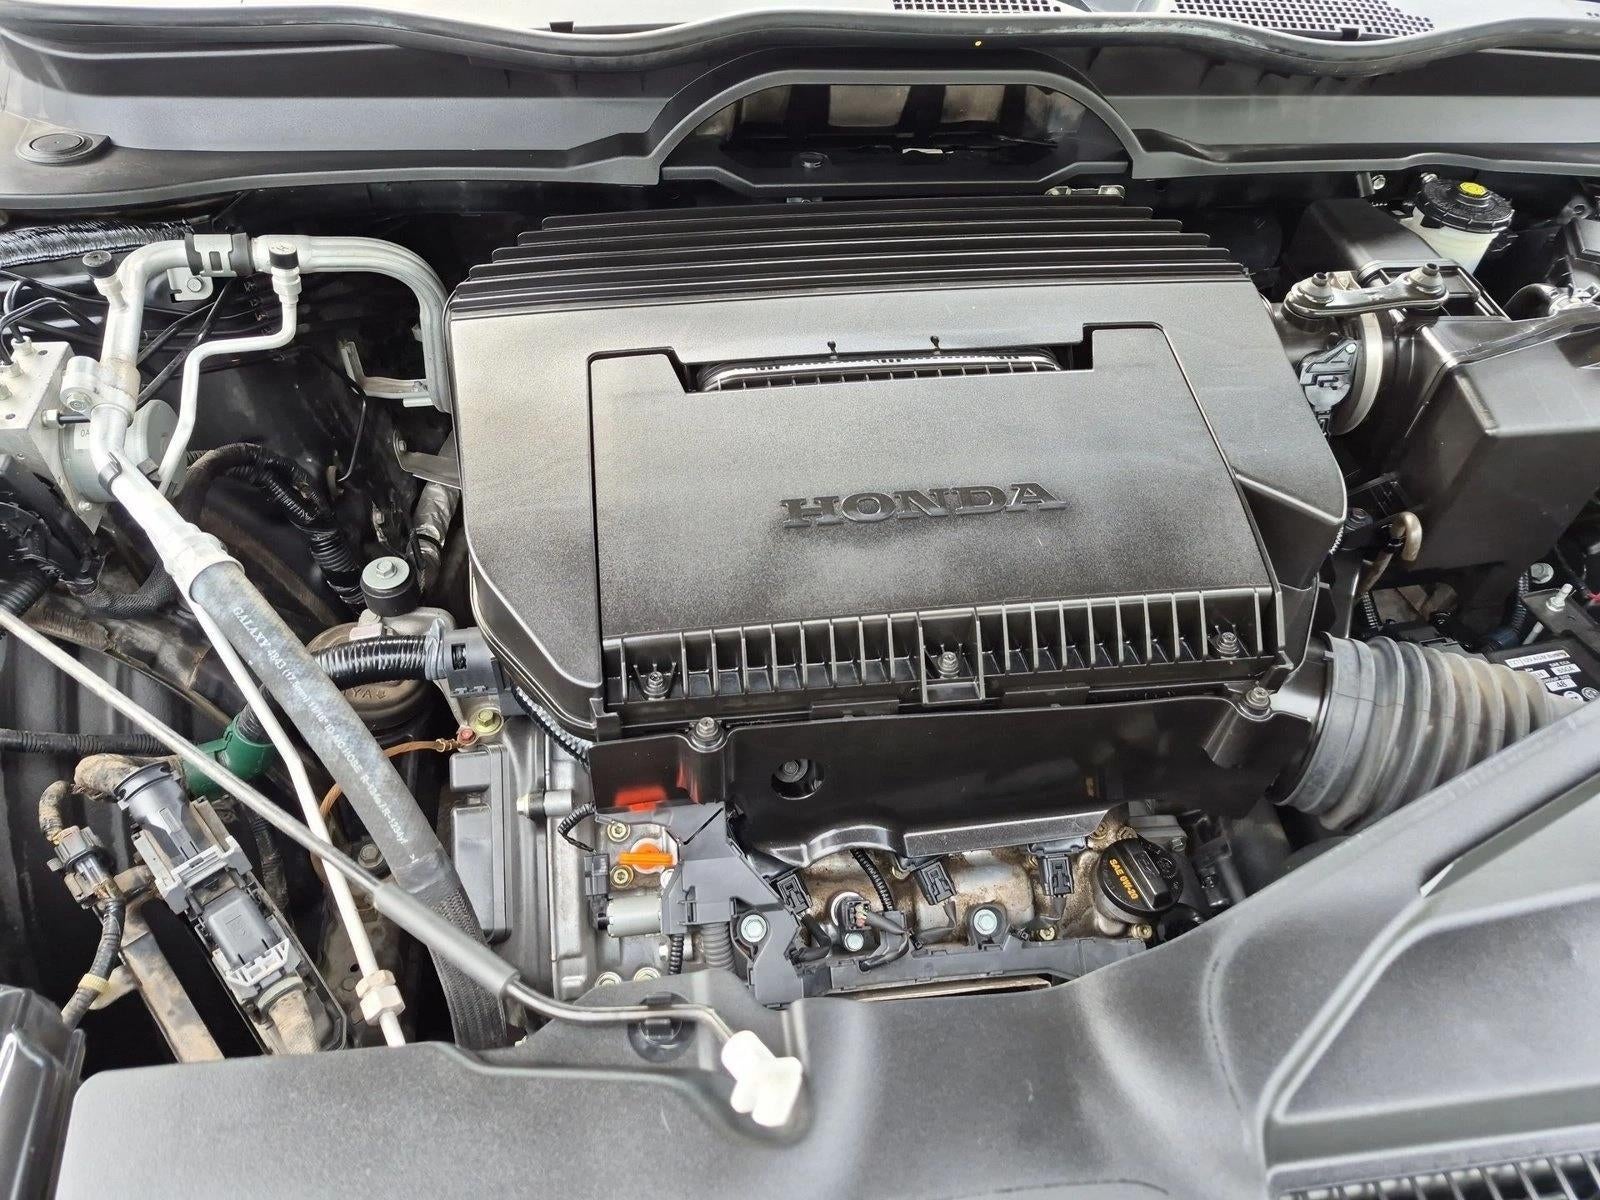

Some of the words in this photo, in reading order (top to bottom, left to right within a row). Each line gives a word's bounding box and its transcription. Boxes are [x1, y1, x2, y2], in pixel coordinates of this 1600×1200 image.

[780, 482, 1071, 527] HONDA
[233, 607, 270, 648] GALAXY
[267, 648, 286, 669] 4843
[343, 749, 362, 774] HOSE
[1109, 859, 1124, 875] SAE
[1119, 875, 1138, 899] 0W-20
